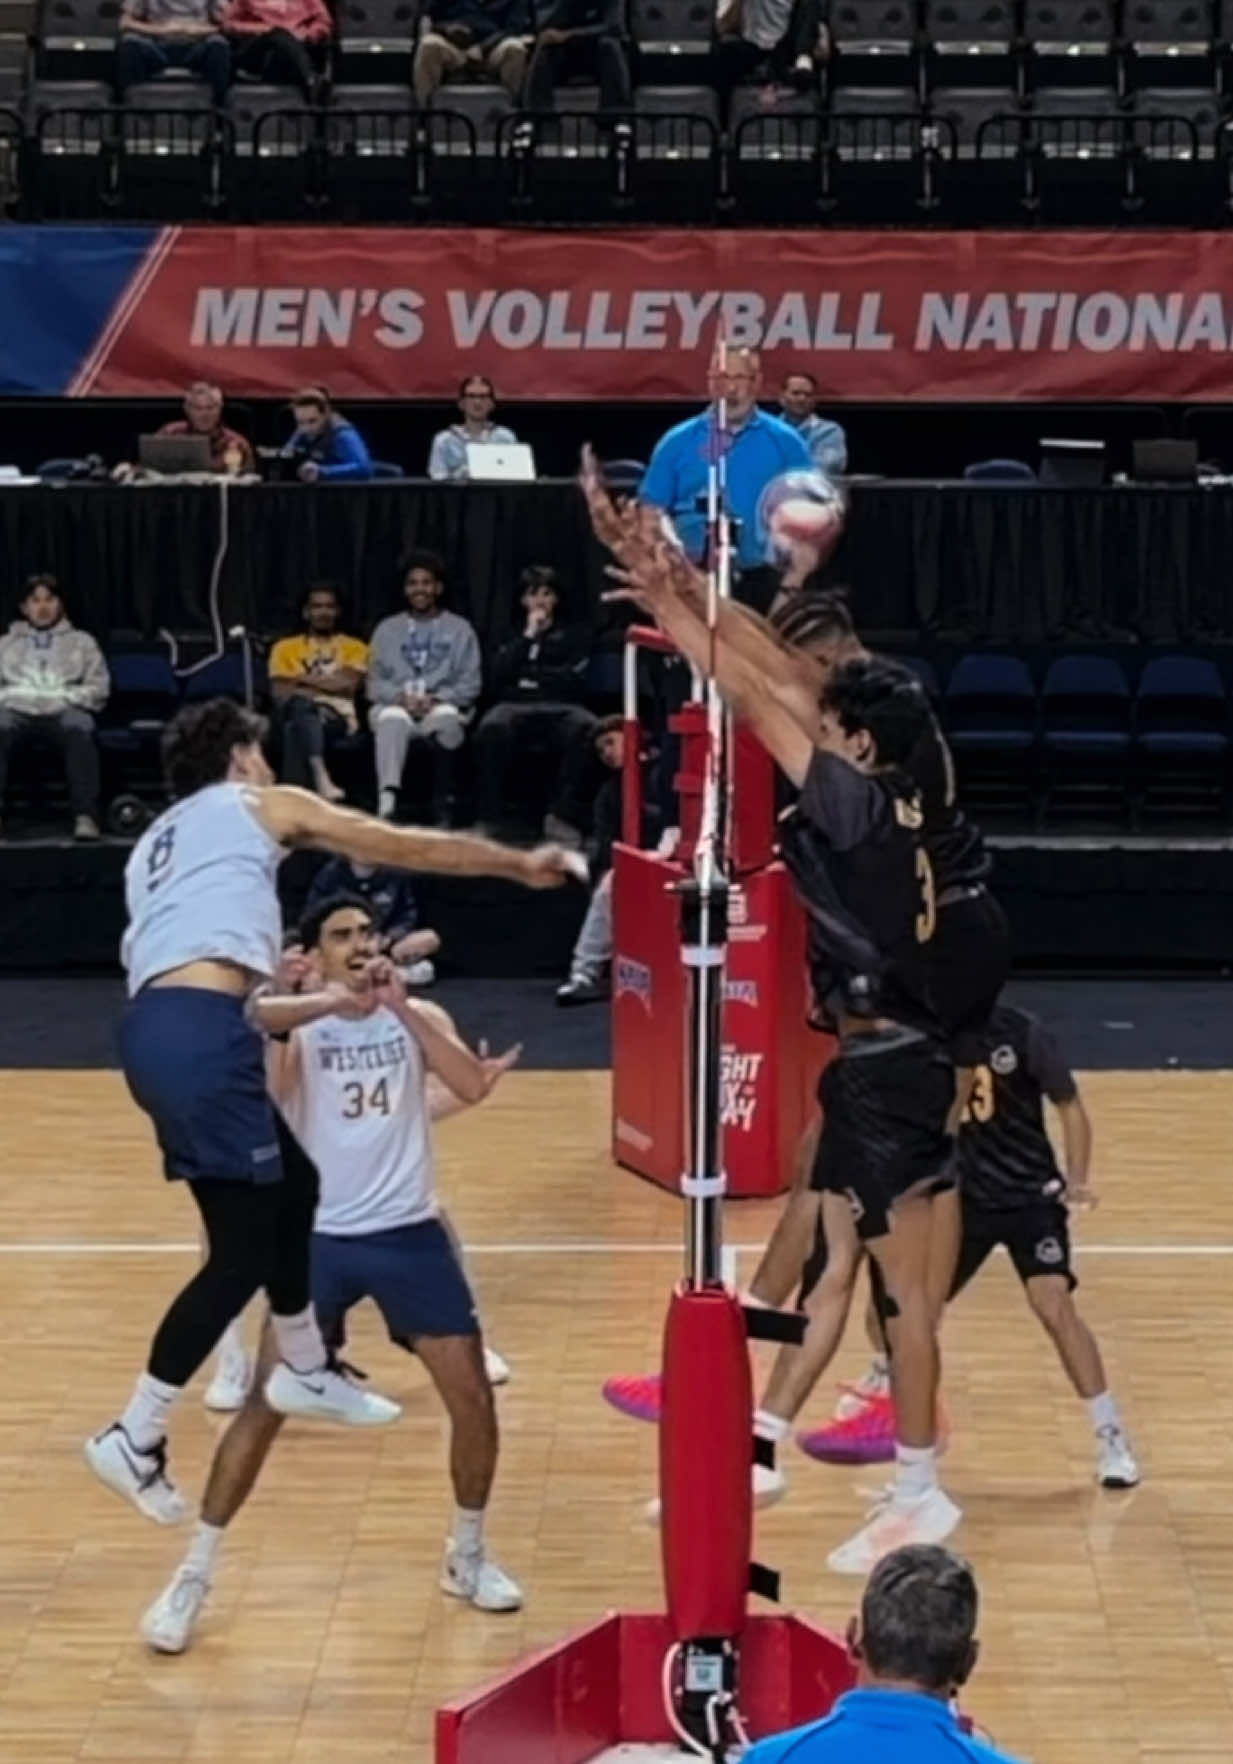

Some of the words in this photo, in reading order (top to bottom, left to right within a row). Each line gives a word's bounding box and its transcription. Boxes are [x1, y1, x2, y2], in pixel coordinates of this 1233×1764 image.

[190, 287, 425, 347] MEN'S
[447, 290, 895, 350] VOLLEYBALL
[914, 292, 1233, 352] NATIONA
[342, 1077, 390, 1119] 34
